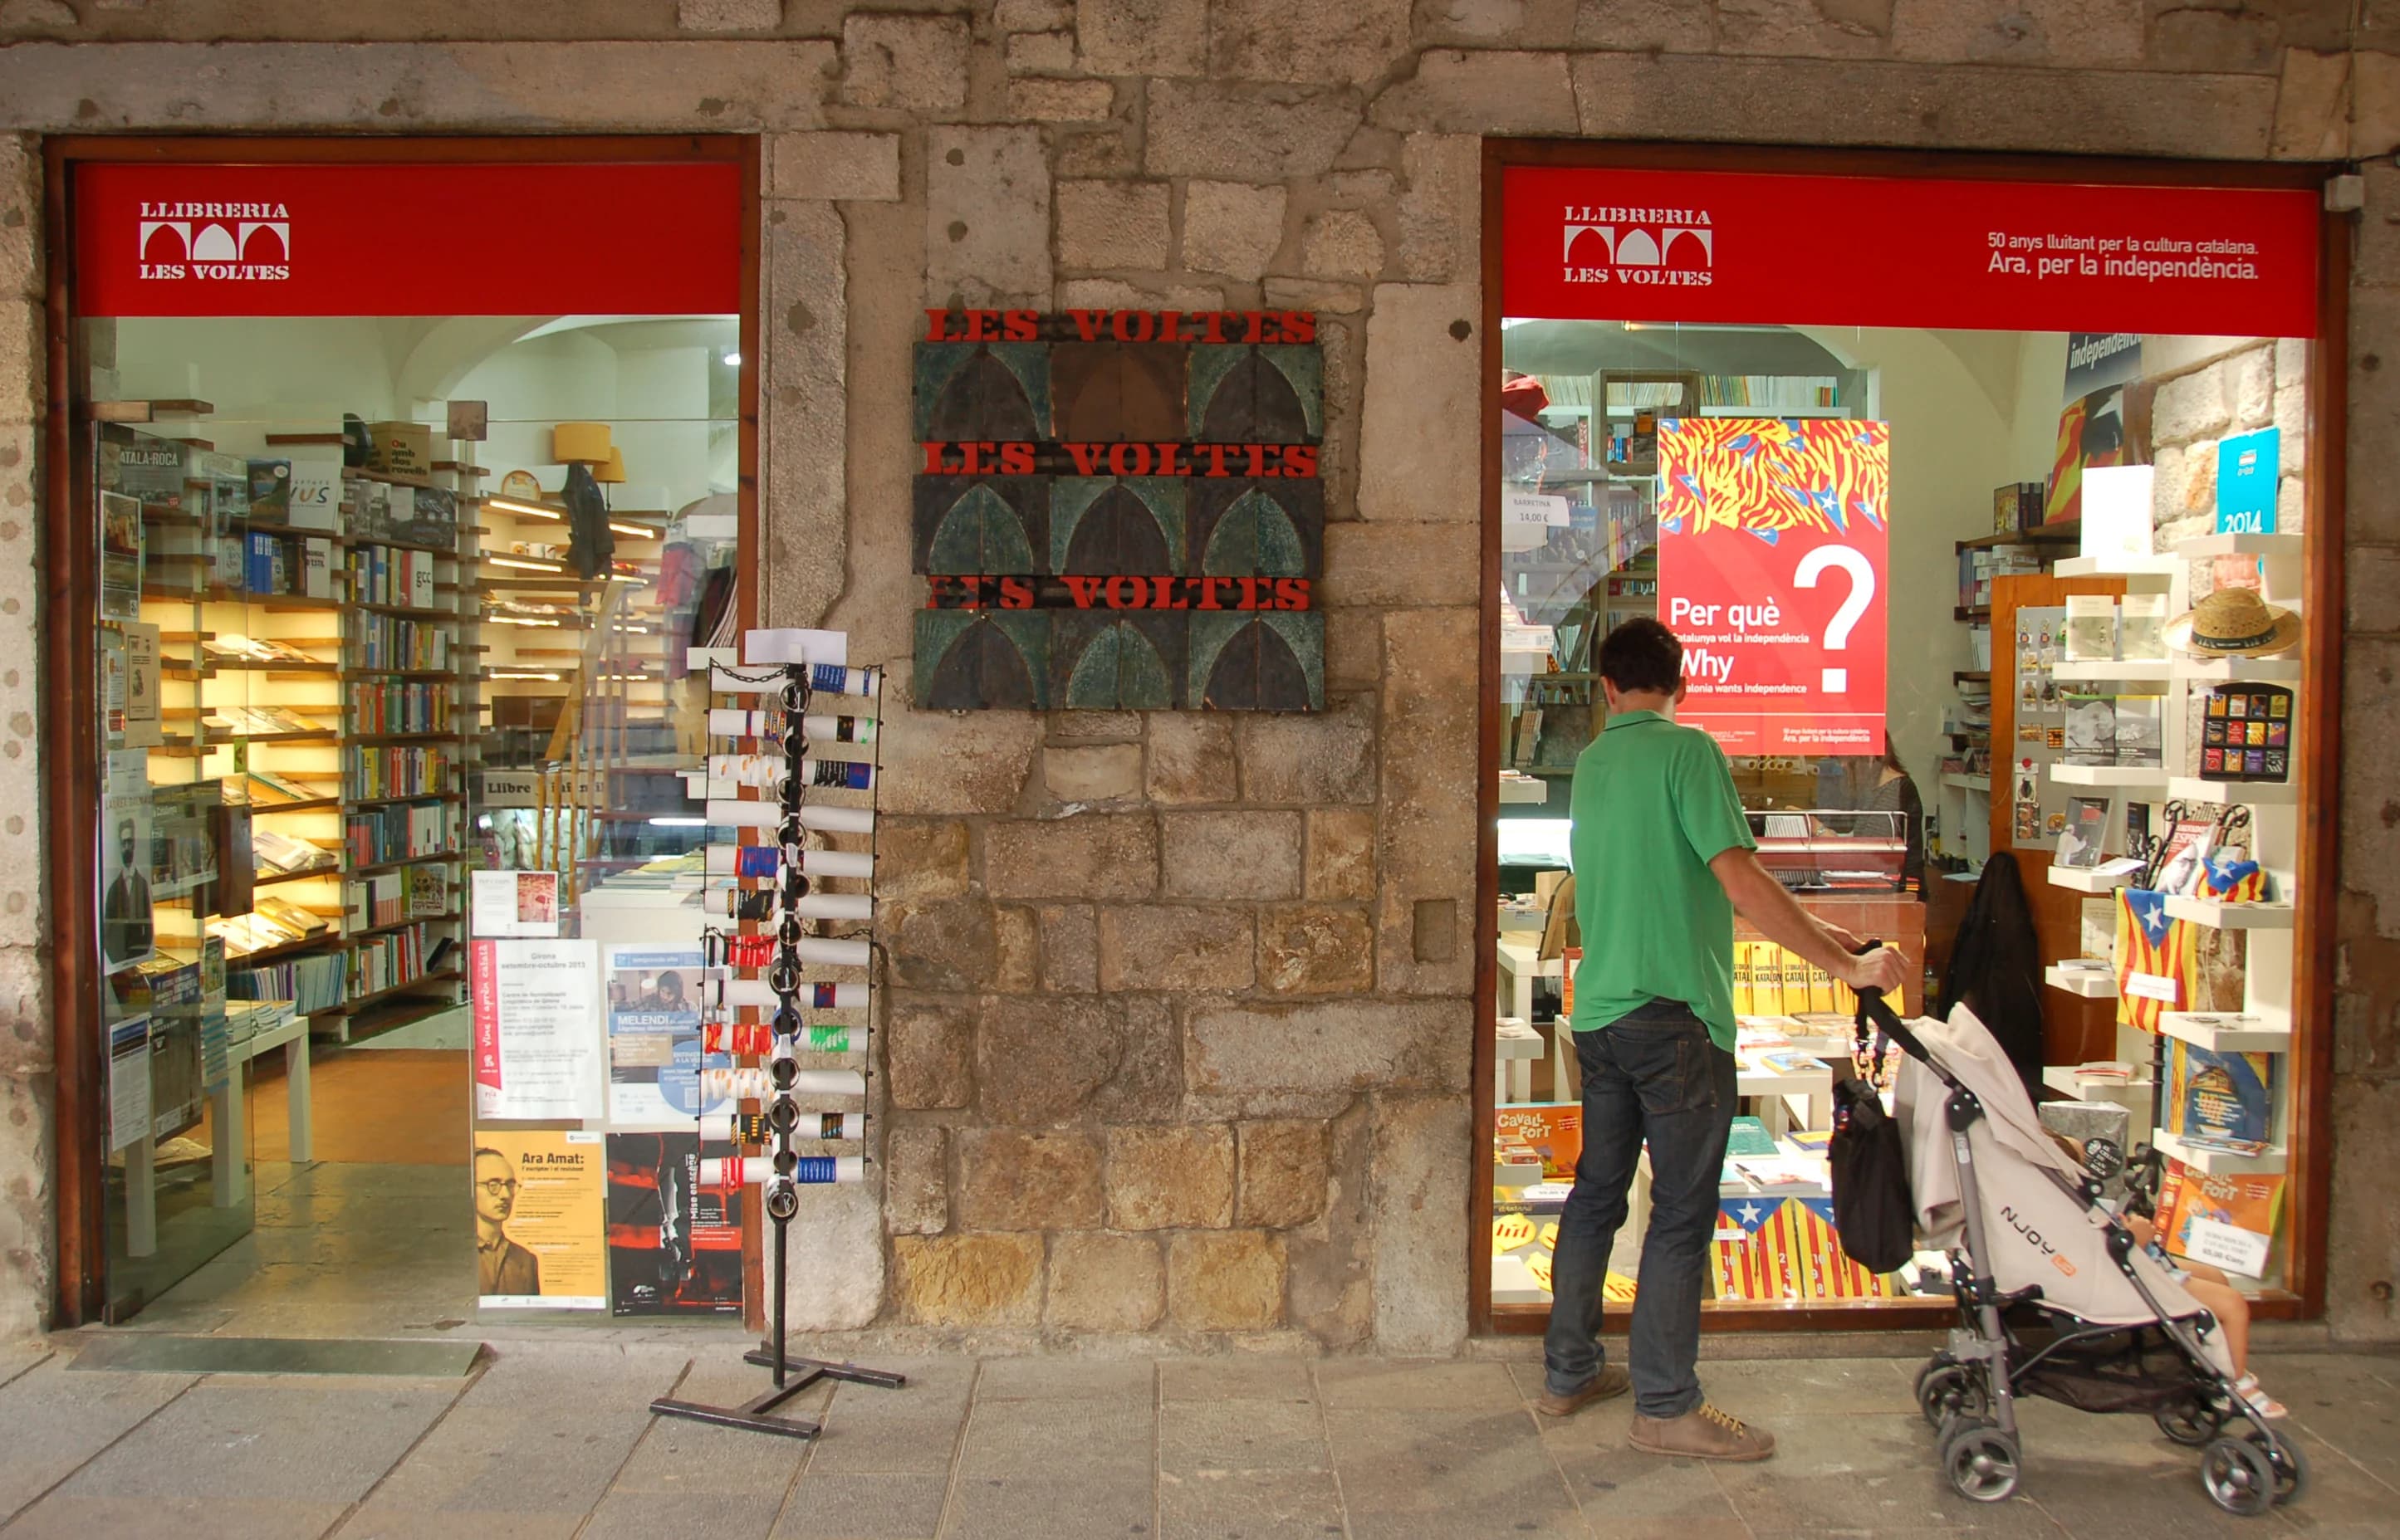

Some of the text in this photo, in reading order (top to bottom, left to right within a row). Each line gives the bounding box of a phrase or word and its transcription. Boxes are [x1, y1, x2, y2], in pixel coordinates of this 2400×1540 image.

[140, 202, 289, 218] LLIBRERIA
[1565, 206, 1712, 225] LLIBRERIA
[1988, 232, 2259, 254] 50 anys lluitant per la cultura catalana.
[140, 264, 290, 281] LES VOLTES
[1988, 251, 2259, 282] Ara, per la independència.
[1564, 267, 1713, 286] LES VOLTES
[924, 309, 1316, 345] LES VOLTES
[921, 441, 1318, 477] LES VOLTES
[1520, 512, 1541, 523] 14,00
[2224, 509, 2263, 534] 2014
[1060, 575, 1310, 612] VOLTES
[1670, 595, 1780, 633] Per què
[1718, 633, 1731, 643] vol
[1733, 633, 1742, 643] la
[1745, 632, 1810, 646] independència
[1715, 685, 1742, 693] wants
[1745, 683, 1807, 694] independence
[487, 783, 531, 794] Llibre
[618, 1014, 669, 1025] MELENDI
[522, 1152, 585, 1164] Ara Amat:
[2000, 1205, 2055, 1255] NJOY
[1722, 1270, 1729, 1282] 9
[1811, 1268, 1819, 1279] 9
[1816, 1283, 1824, 1294] 8
